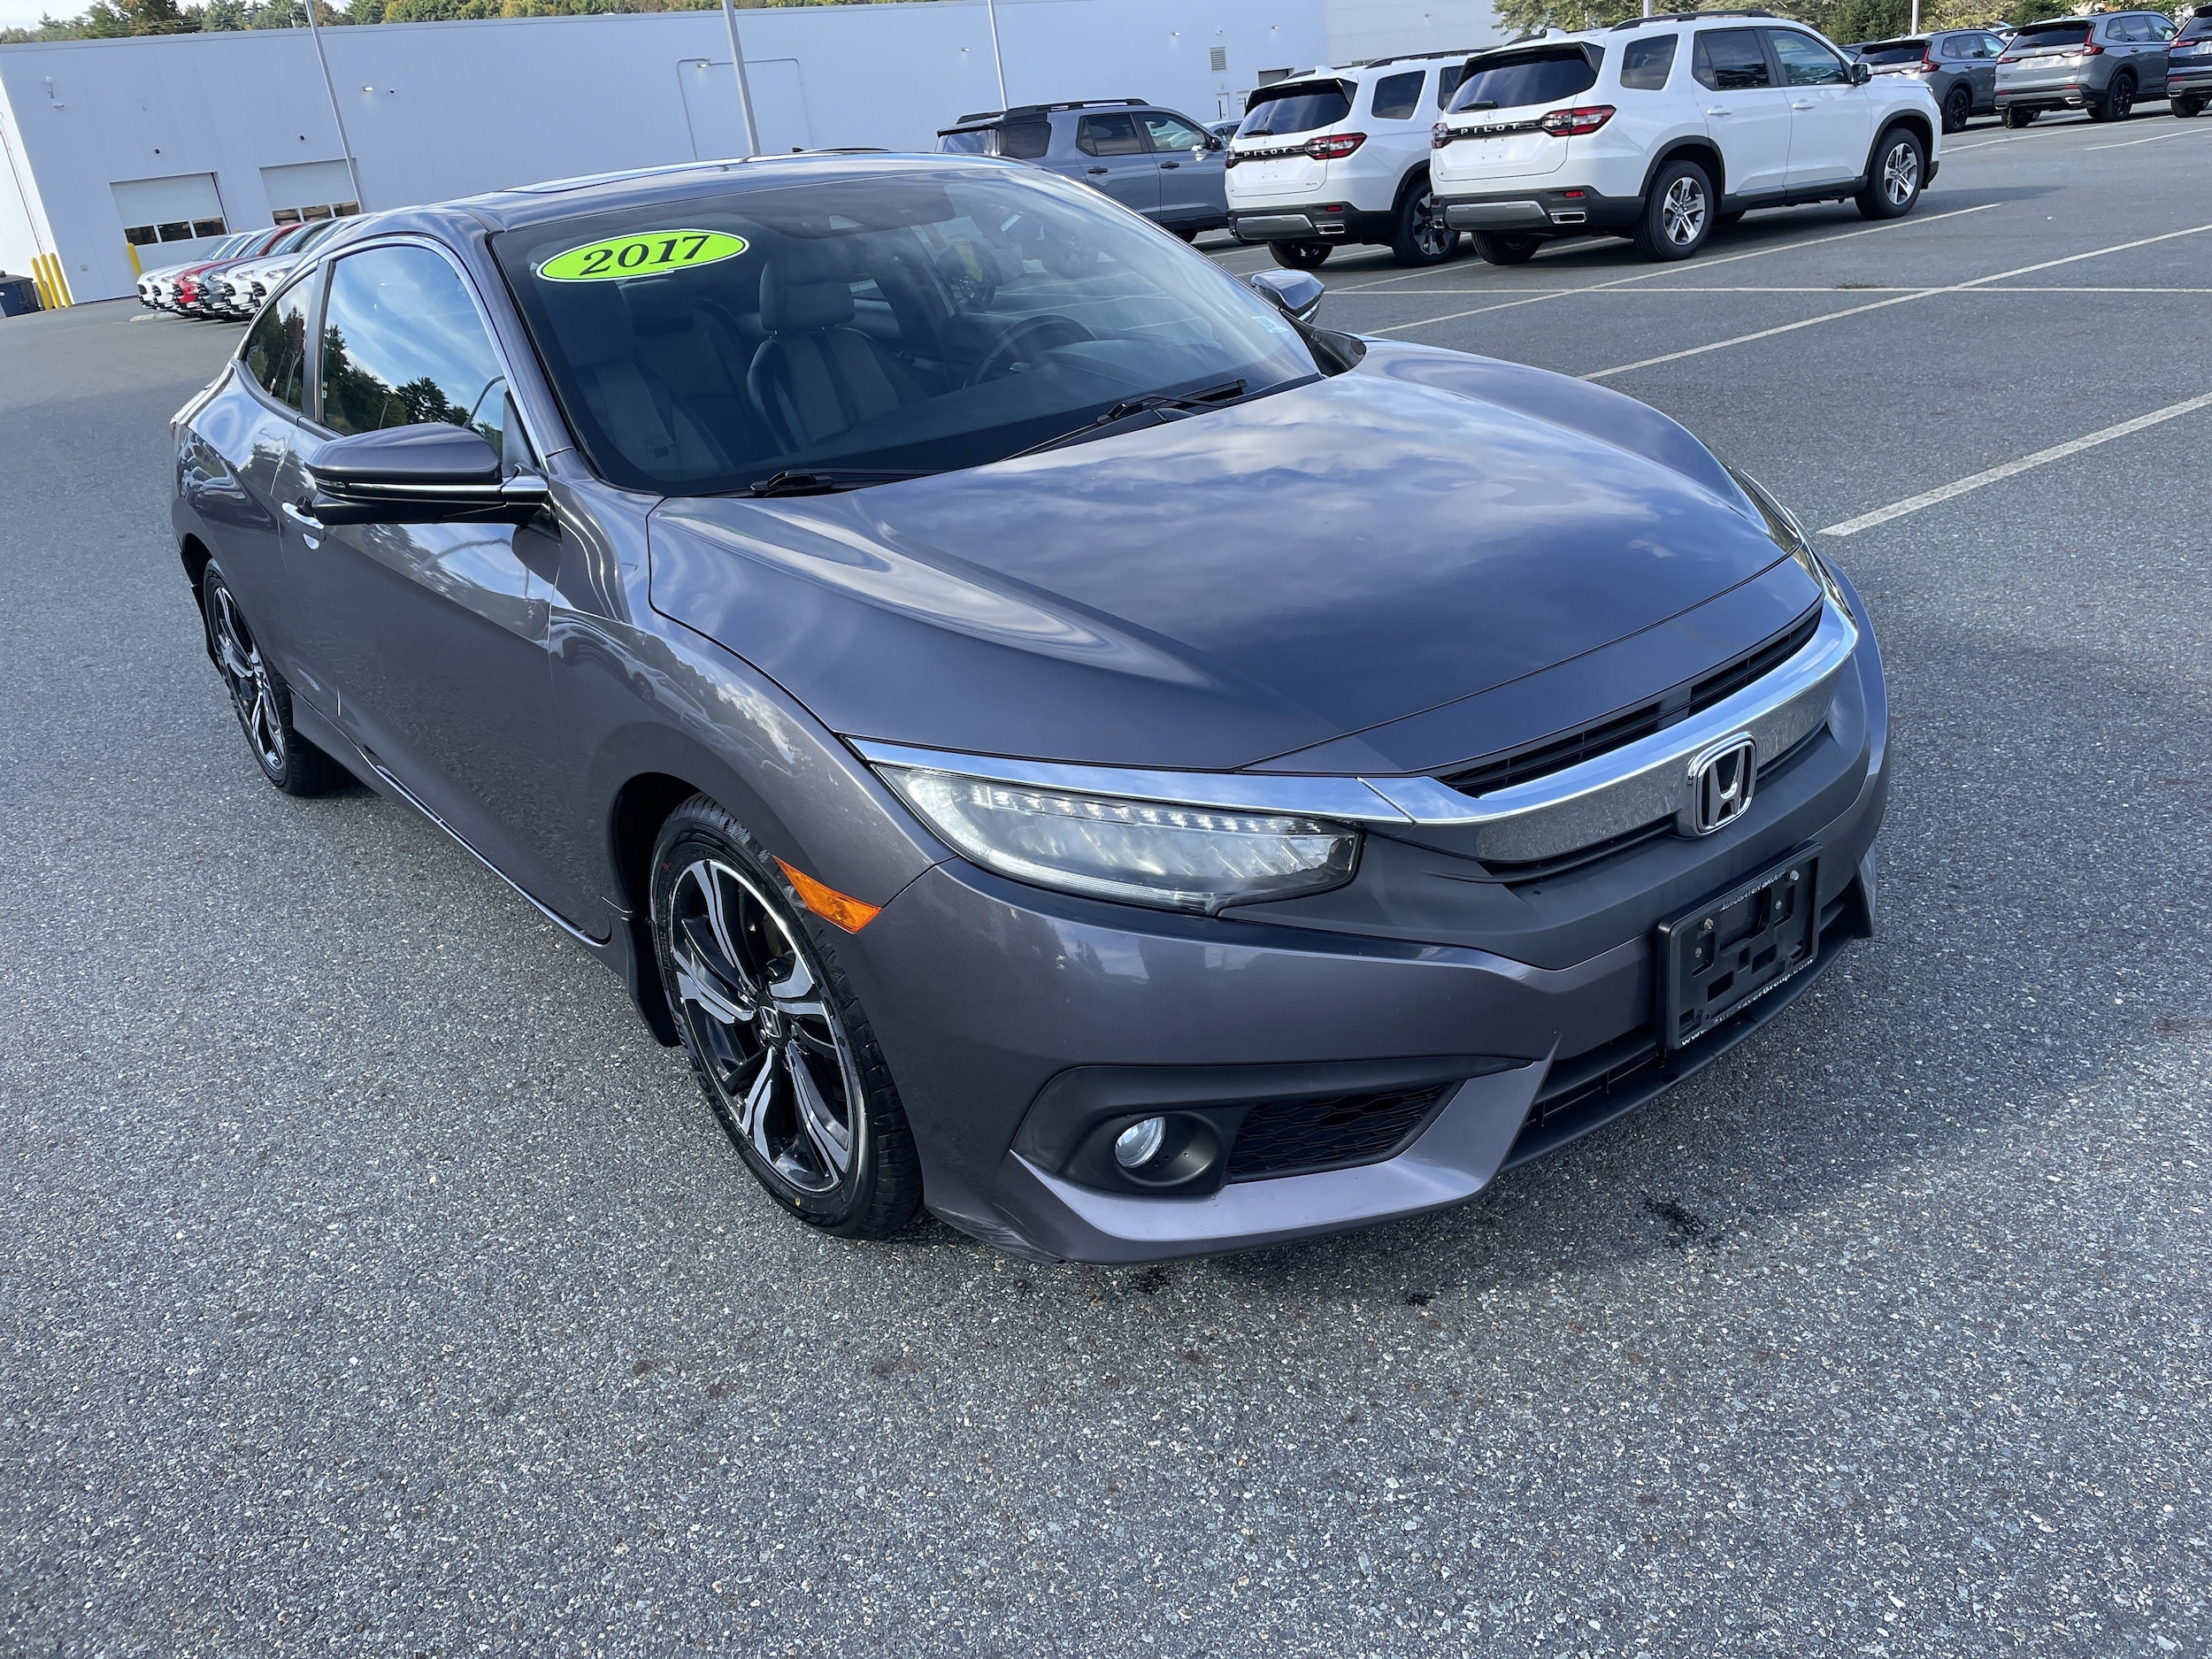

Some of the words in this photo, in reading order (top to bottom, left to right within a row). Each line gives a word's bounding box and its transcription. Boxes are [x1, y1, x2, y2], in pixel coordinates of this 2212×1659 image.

[1461, 122, 1520, 135] PILOT
[1243, 147, 1289, 157] PILOT
[579, 234, 710, 276] 2017
[1681, 958, 1813, 1046] wwwAuSaverGroup.com
